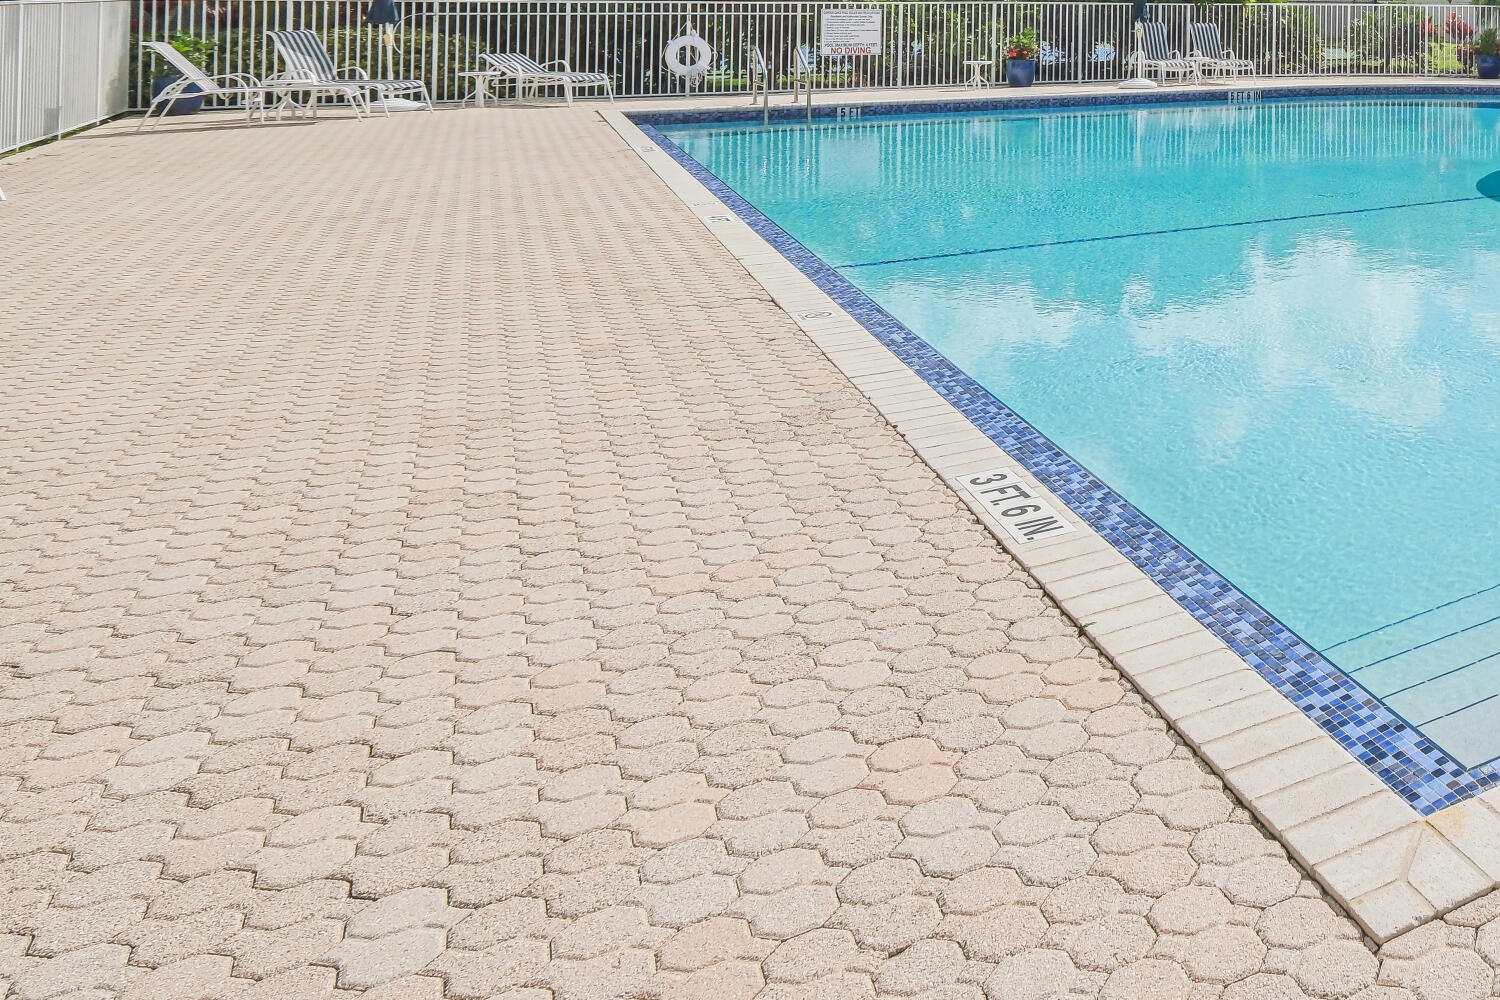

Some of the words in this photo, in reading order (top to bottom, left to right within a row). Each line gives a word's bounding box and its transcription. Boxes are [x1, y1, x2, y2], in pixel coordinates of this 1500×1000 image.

[969, 473, 1008, 486] 3
[980, 484, 1031, 506] FT.
[1001, 504, 1042, 517] 6
[1014, 516, 1065, 541] IN.
